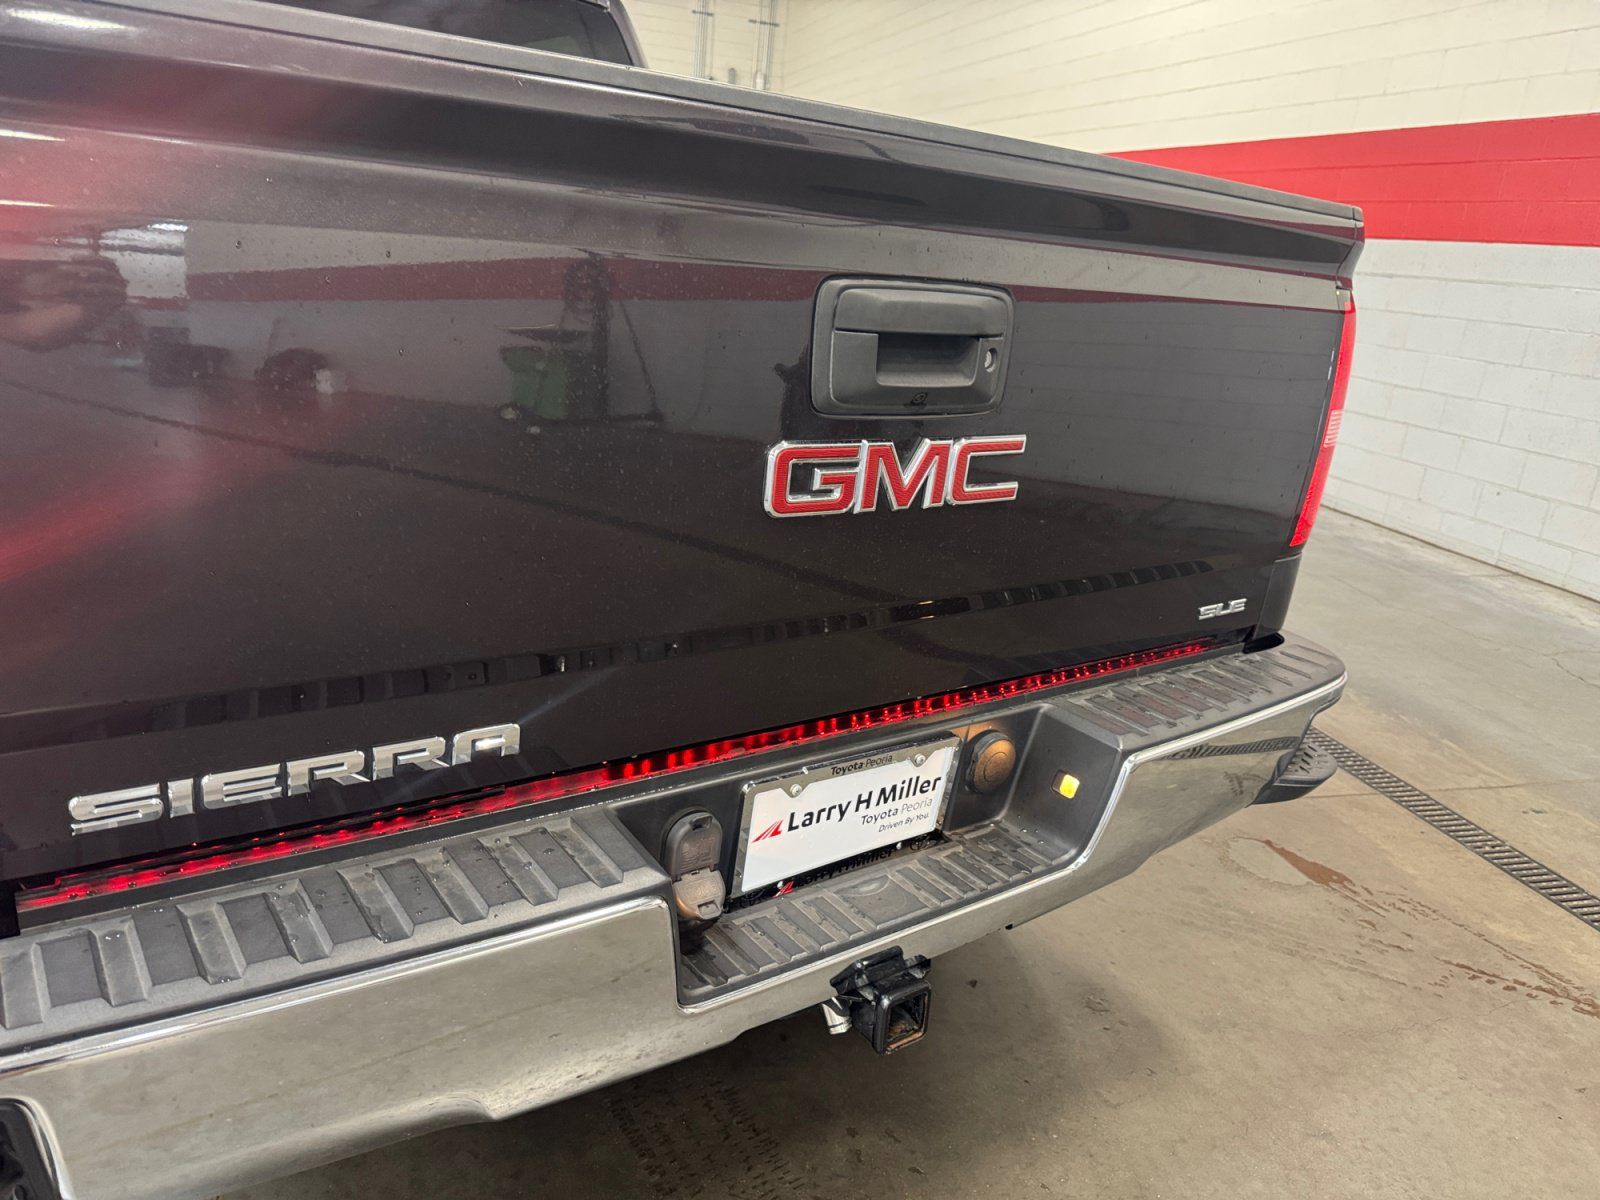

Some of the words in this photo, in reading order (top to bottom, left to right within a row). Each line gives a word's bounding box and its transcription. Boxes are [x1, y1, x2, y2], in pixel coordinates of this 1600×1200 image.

[764, 434, 1027, 517] GMC
[1198, 598, 1247, 620] SLE
[831, 763, 864, 776] Toyota
[865, 754, 893, 768] Peoria
[68, 723, 520, 836] SIERRA
[787, 799, 852, 833] Larry
[855, 790, 873, 812] H
[875, 776, 942, 807] Miller
[861, 807, 899, 825] Toyota
[901, 797, 933, 813] Peoria
[879, 819, 903, 832] Driven
[904, 815, 914, 825] By
